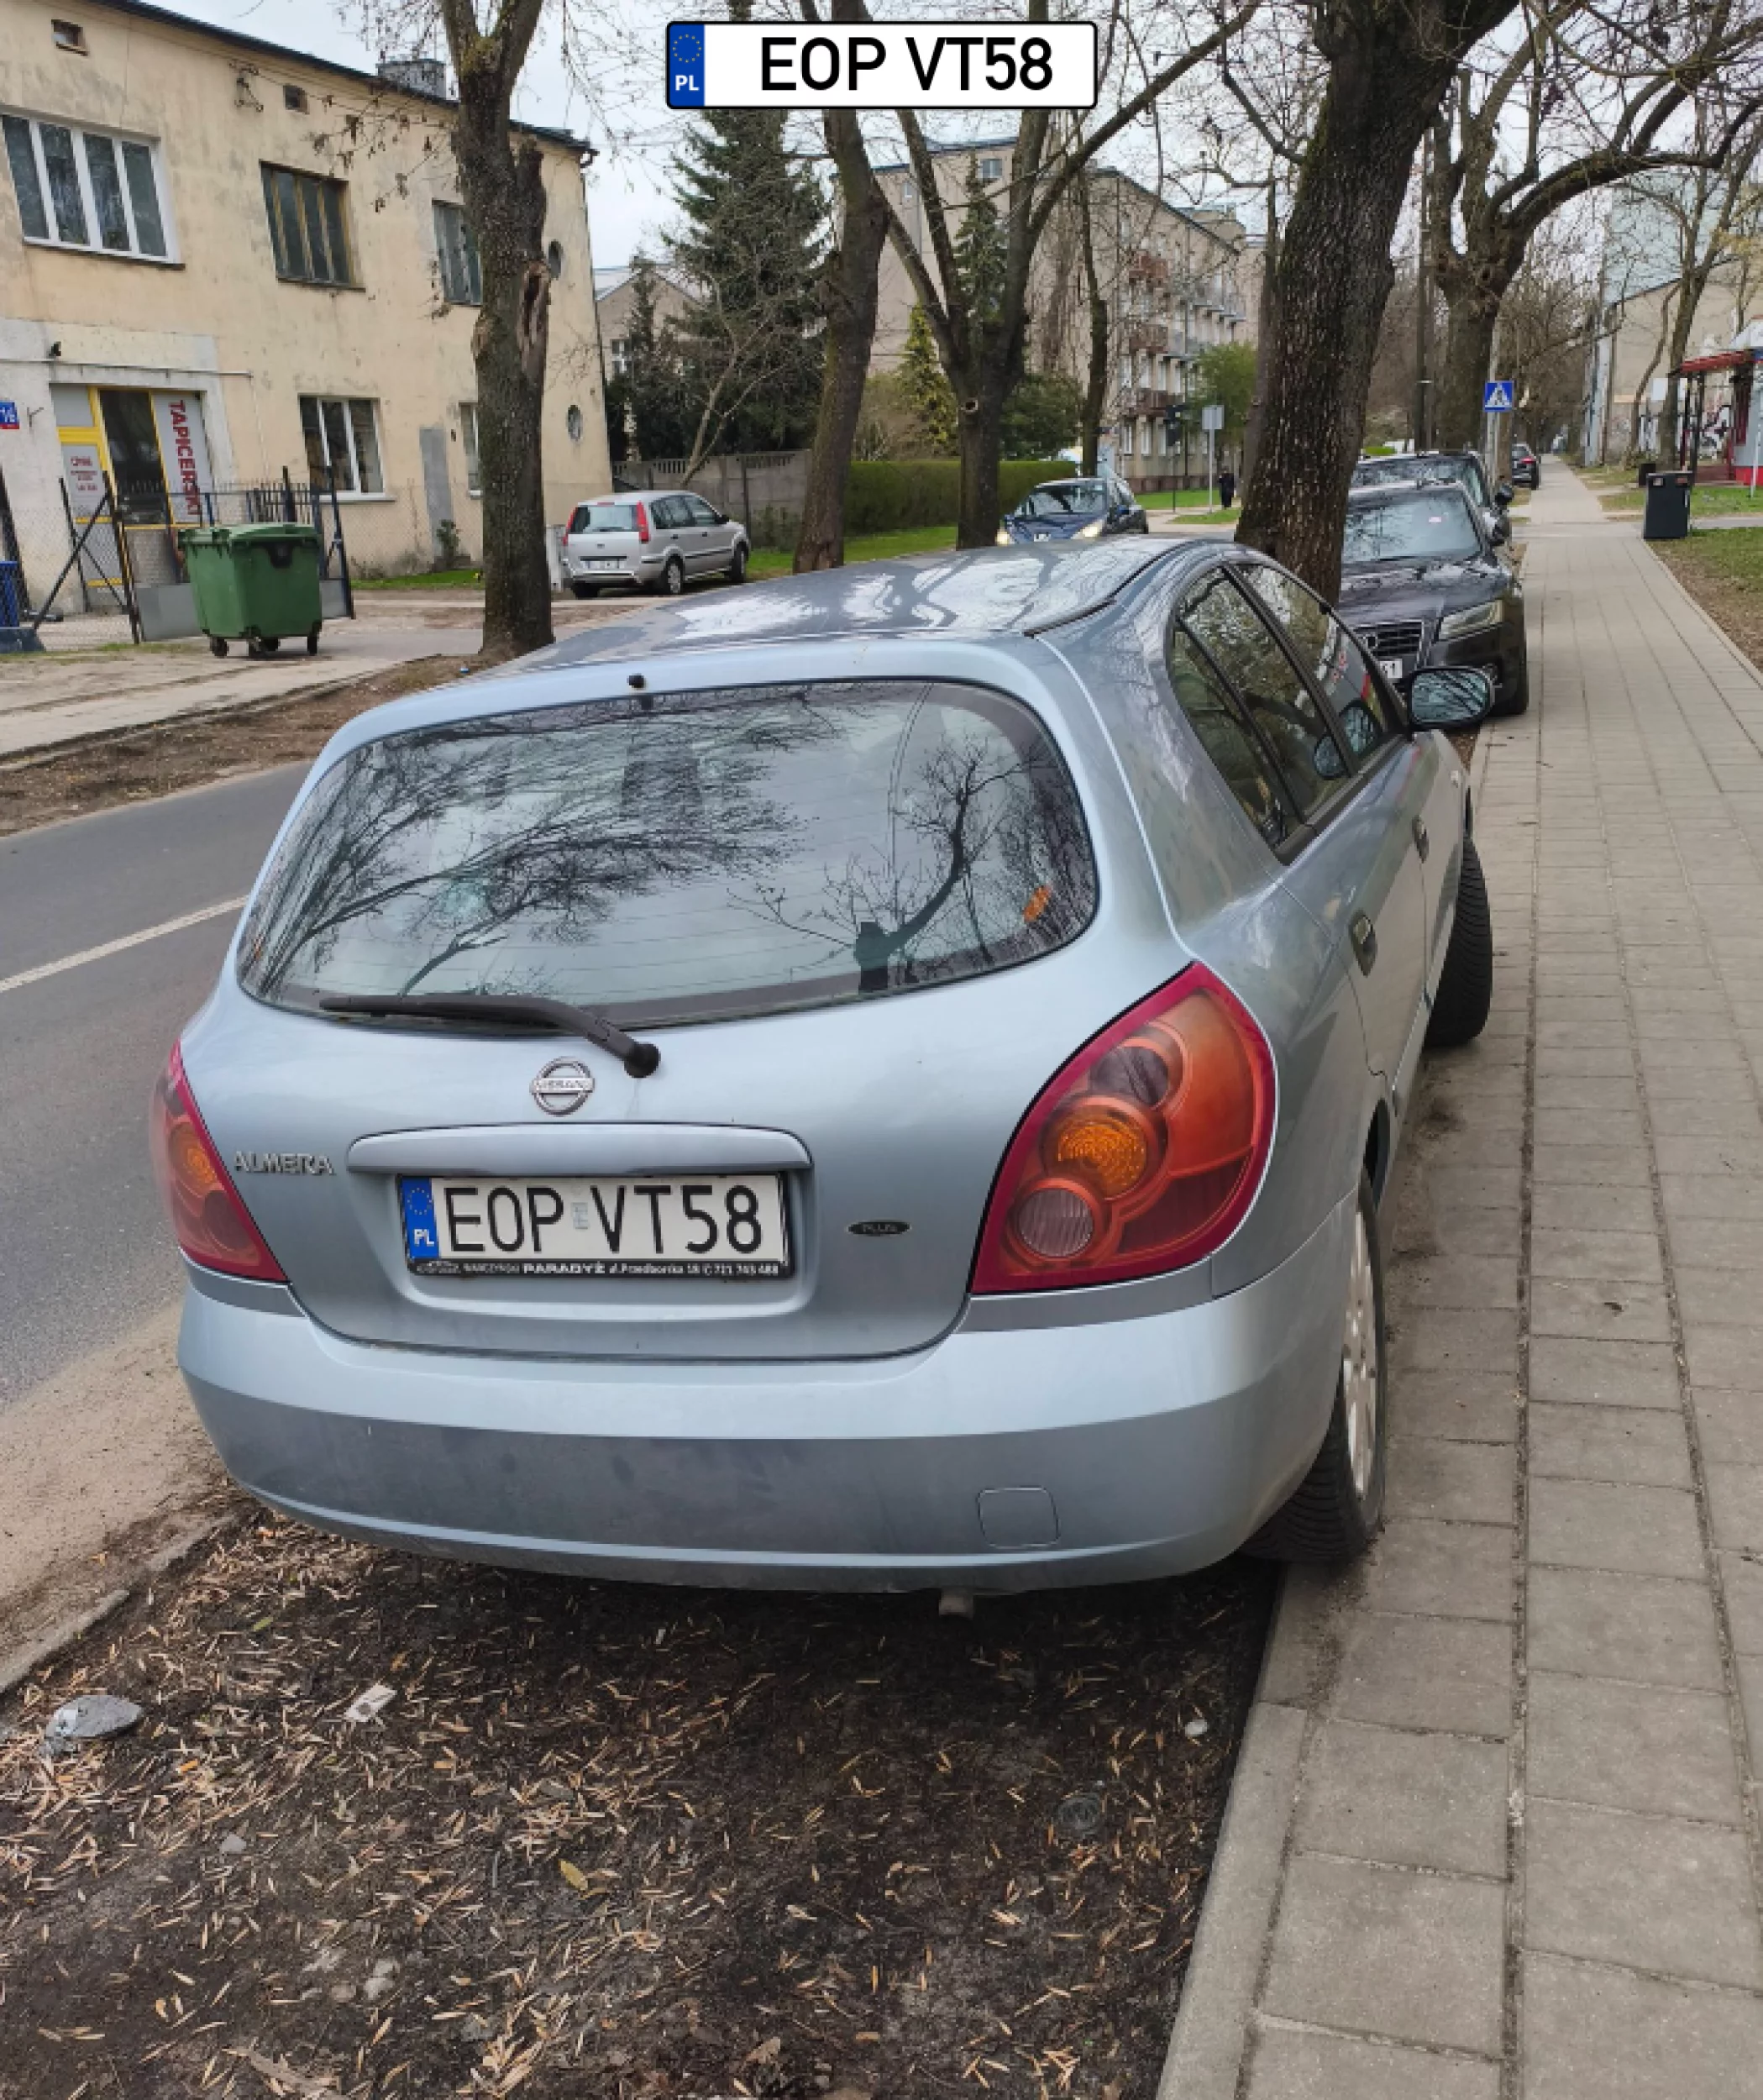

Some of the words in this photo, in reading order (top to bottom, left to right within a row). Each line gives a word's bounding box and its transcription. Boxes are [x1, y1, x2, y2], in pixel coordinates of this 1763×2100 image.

[233, 1150, 335, 1175] ALMERA
[443, 1186, 564, 1253] EOP
[590, 1184, 763, 1254] VT58
[413, 1228, 435, 1247] PL
